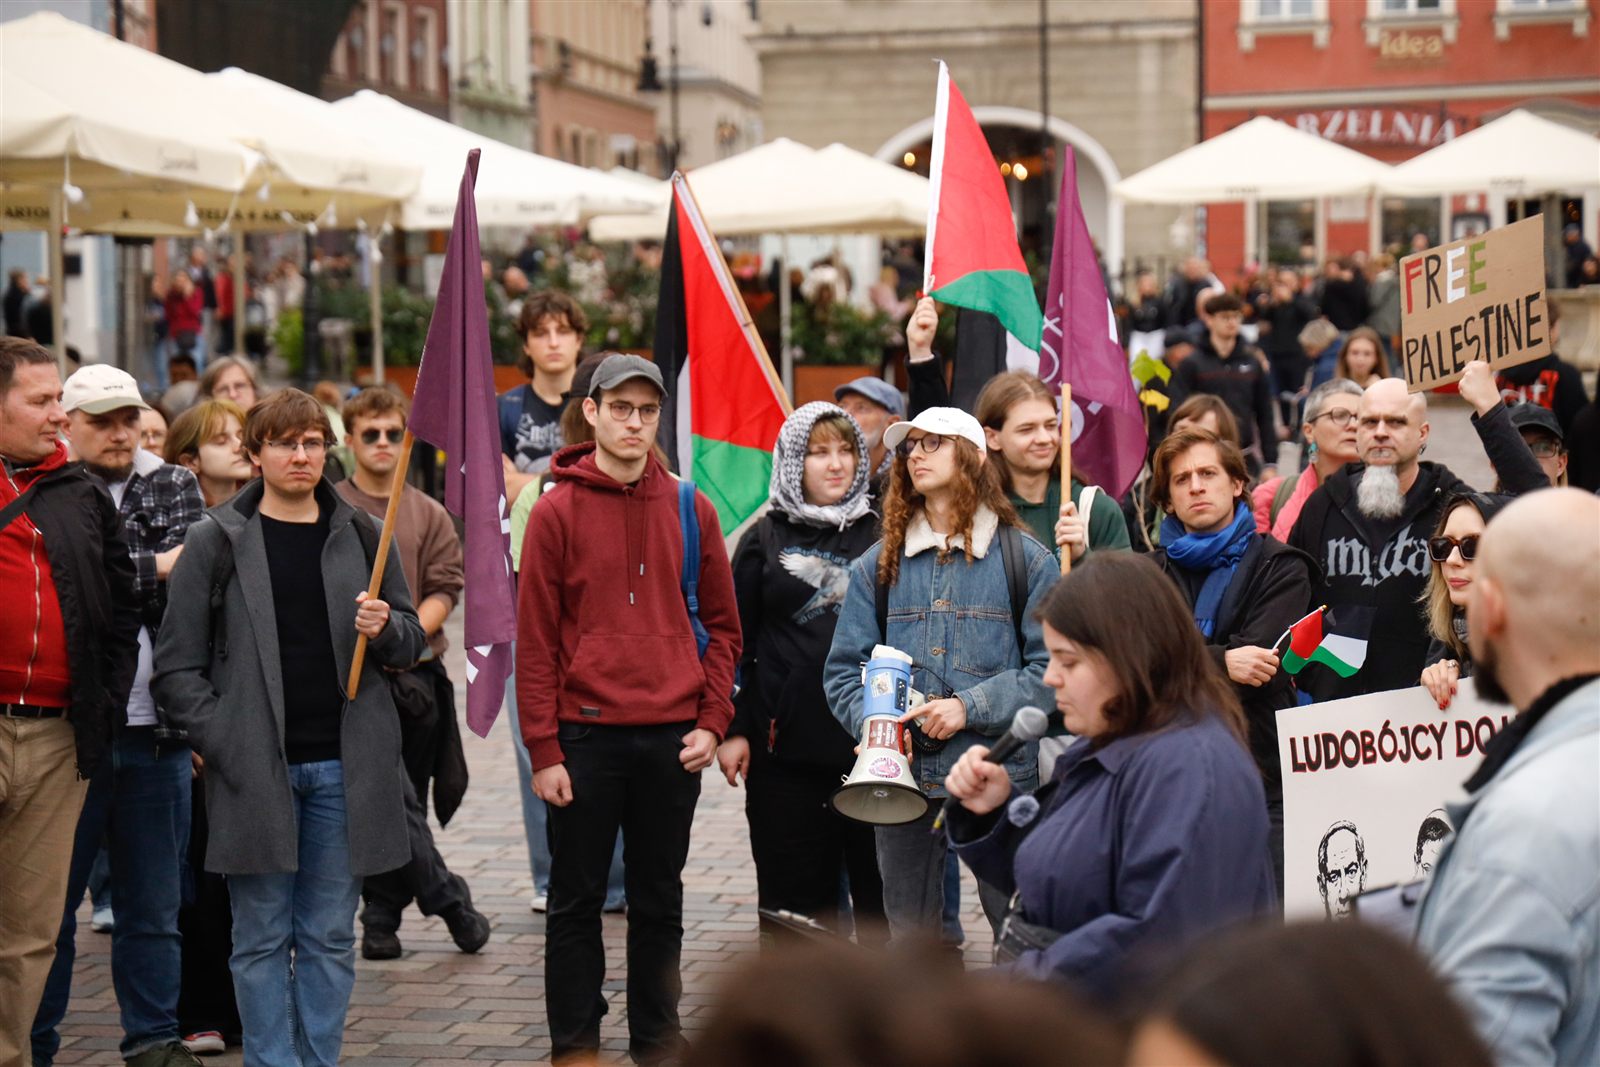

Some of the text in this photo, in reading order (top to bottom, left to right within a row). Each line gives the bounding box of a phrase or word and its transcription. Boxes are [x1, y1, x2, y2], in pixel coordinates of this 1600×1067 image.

[1286, 109, 1457, 145] RZELNIA
[1404, 240, 1487, 315] FREE
[1405, 291, 1543, 385] PALESTINE
[1289, 719, 1448, 773] LUDOBÓJCY
